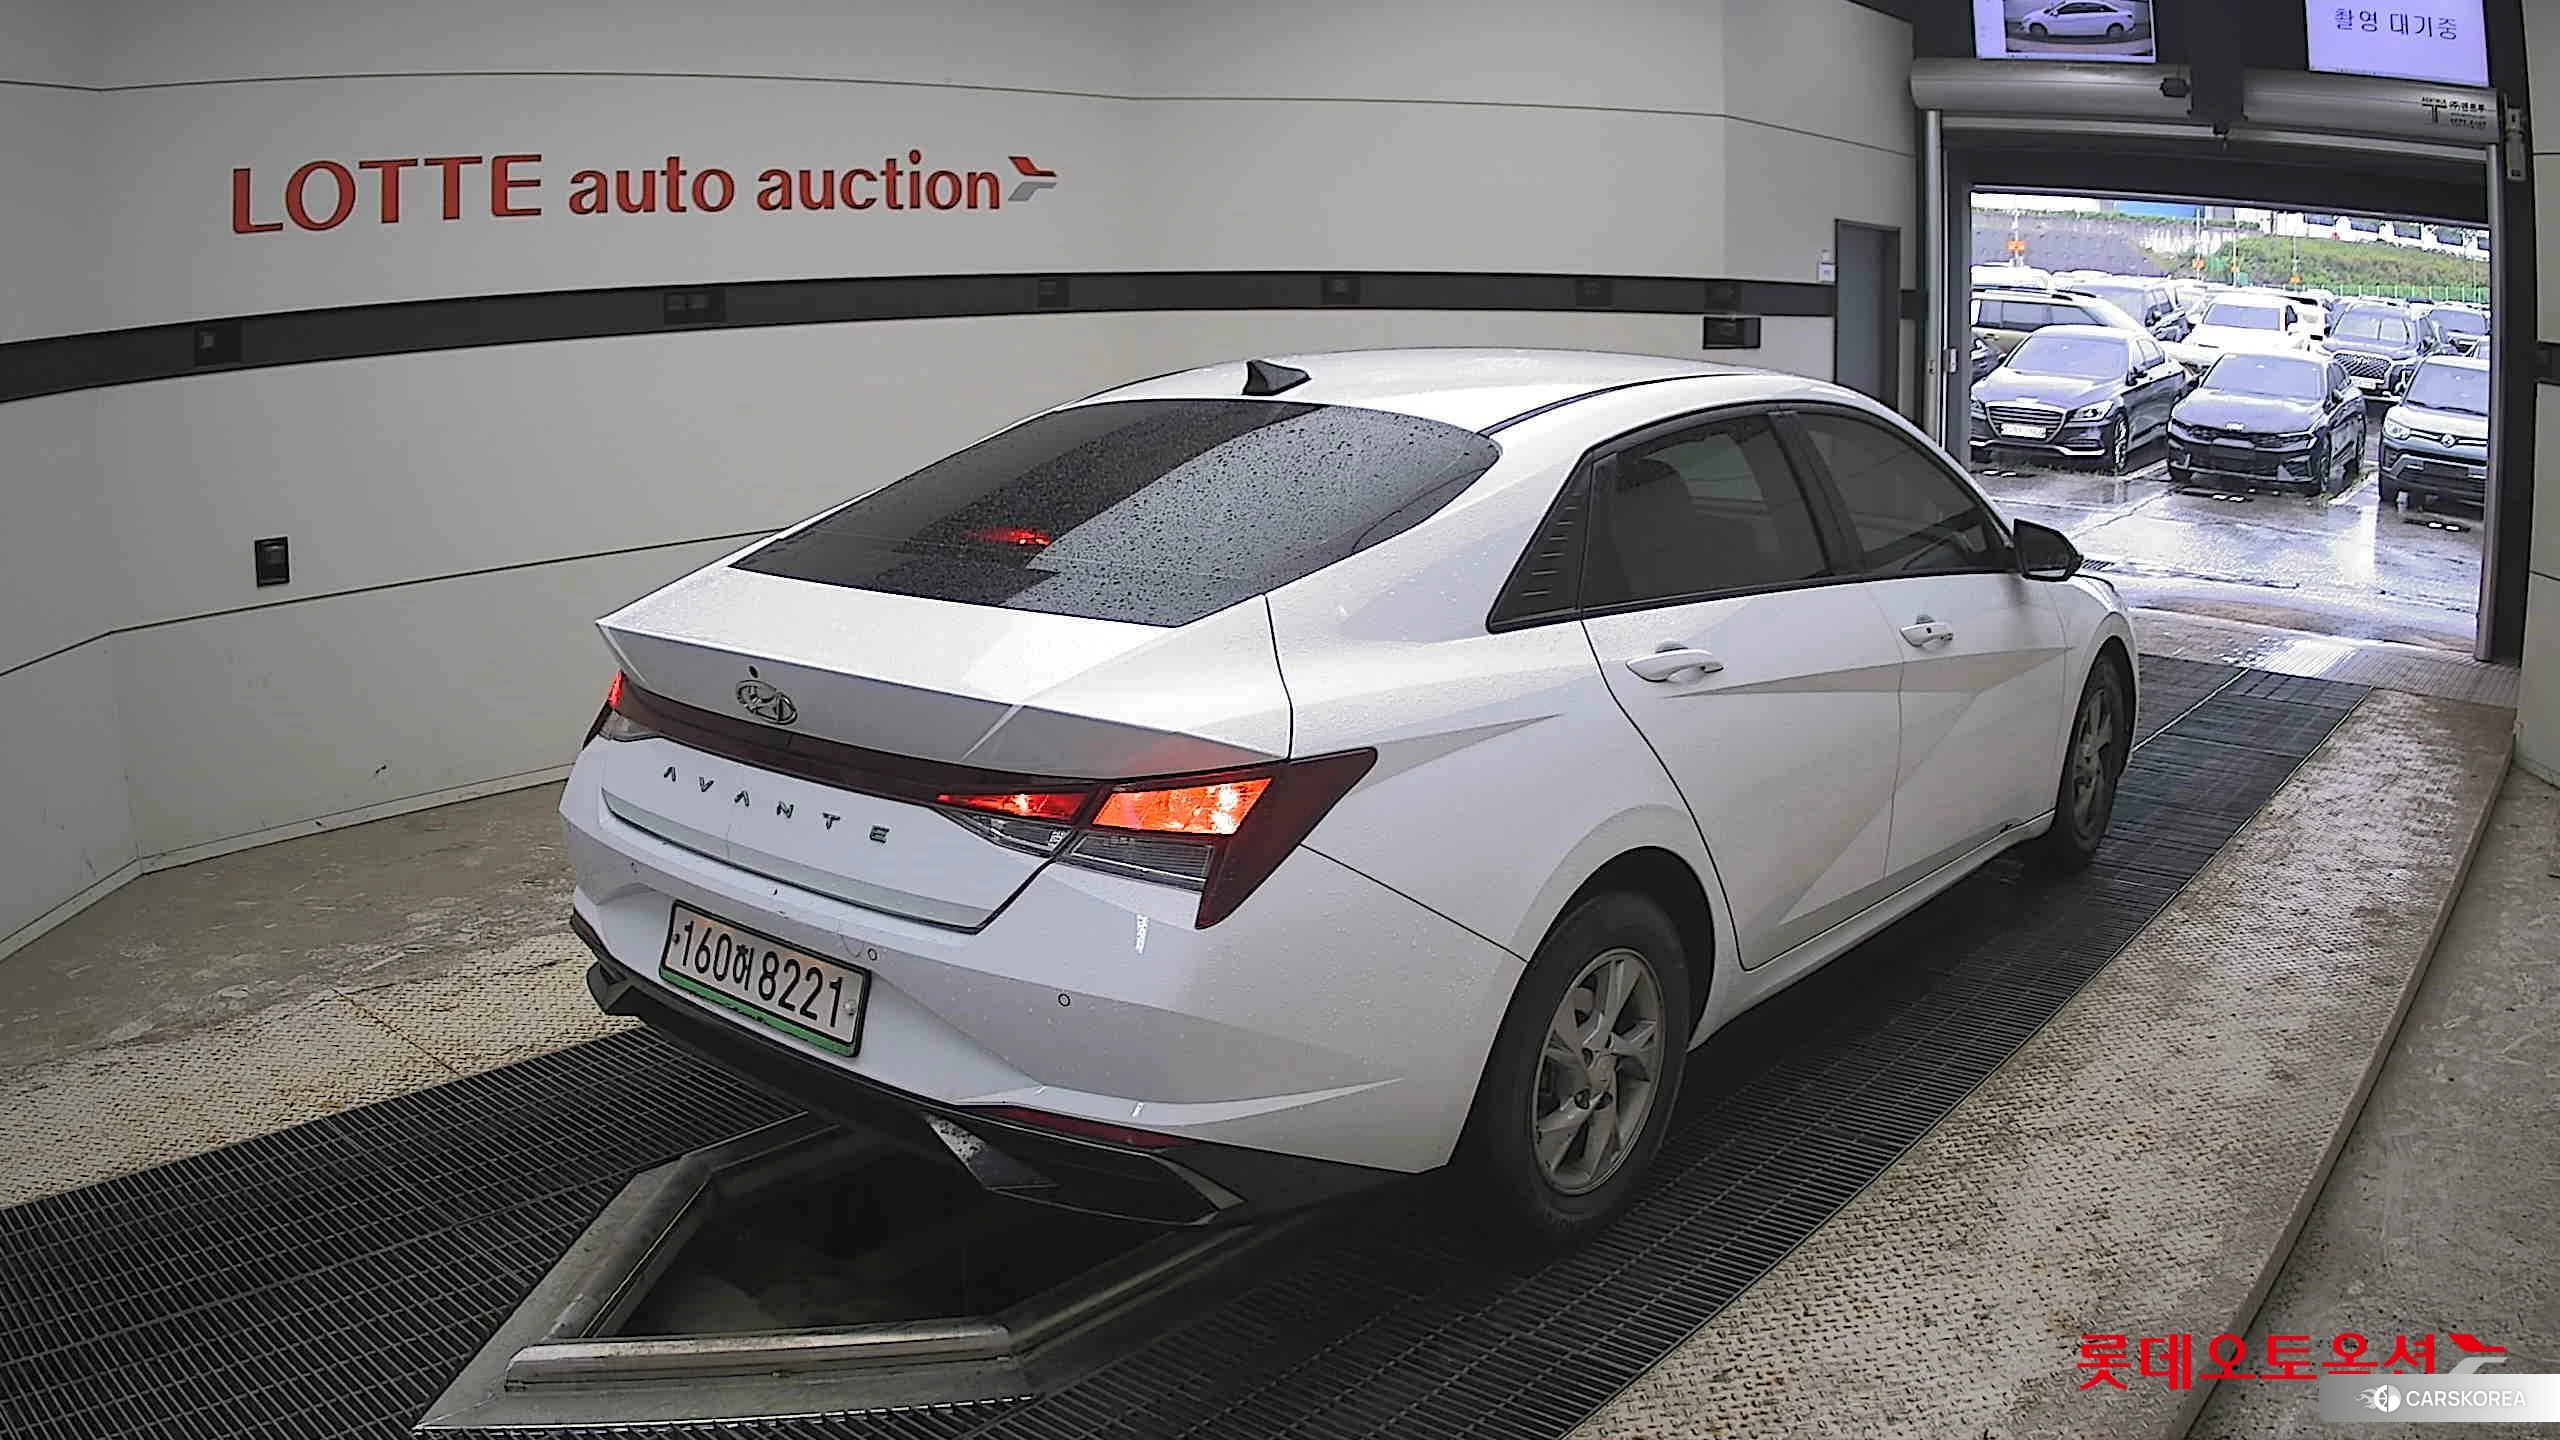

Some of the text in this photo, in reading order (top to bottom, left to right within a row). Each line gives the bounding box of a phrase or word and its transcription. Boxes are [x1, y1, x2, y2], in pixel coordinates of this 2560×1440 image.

[2335, 8, 2457, 40] 촬영 대기중
[233, 149, 1001, 234] LOTTE auto auction
[663, 766, 890, 843] AVANTE
[682, 920, 843, 1028] 160허8221
